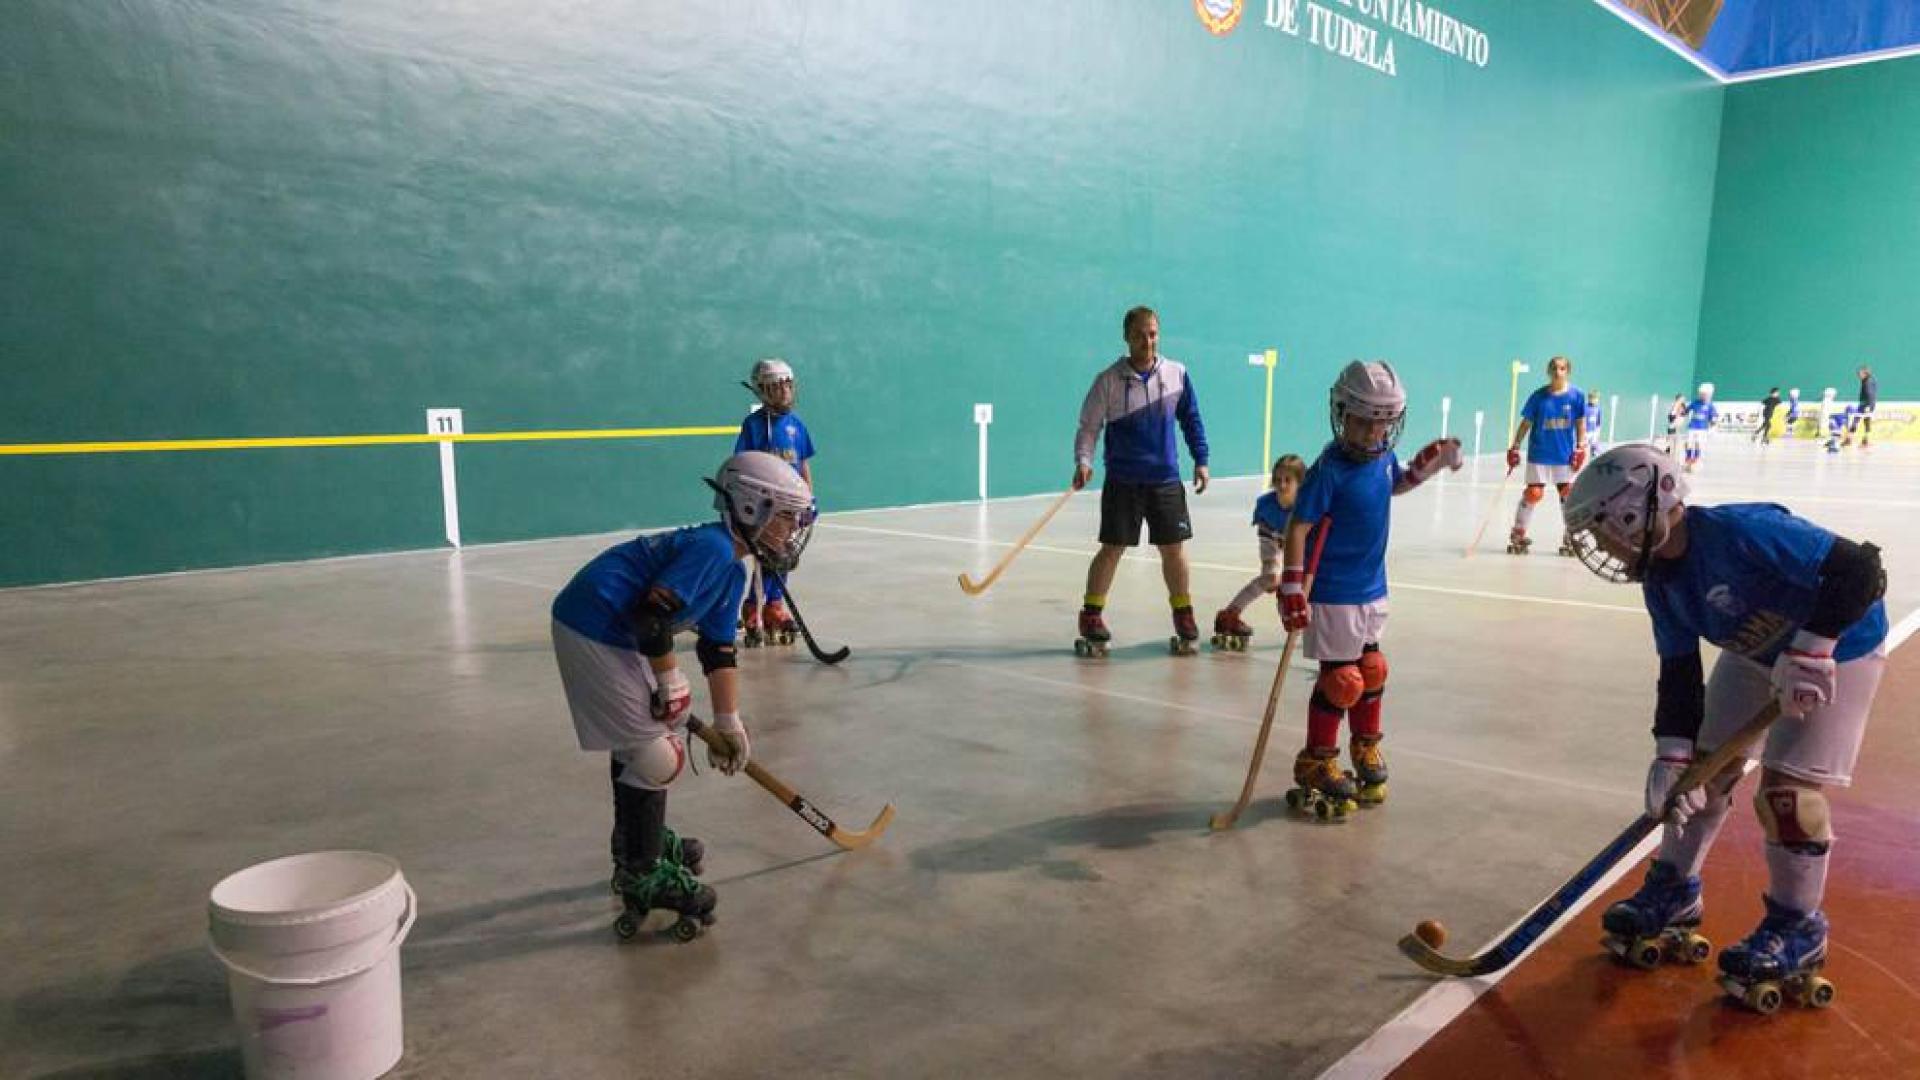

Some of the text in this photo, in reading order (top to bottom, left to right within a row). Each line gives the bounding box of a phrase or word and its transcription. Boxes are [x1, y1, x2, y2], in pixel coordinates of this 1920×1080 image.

[1264, 0, 1397, 77] DE TUDELA
[436, 416, 453, 433] 11
